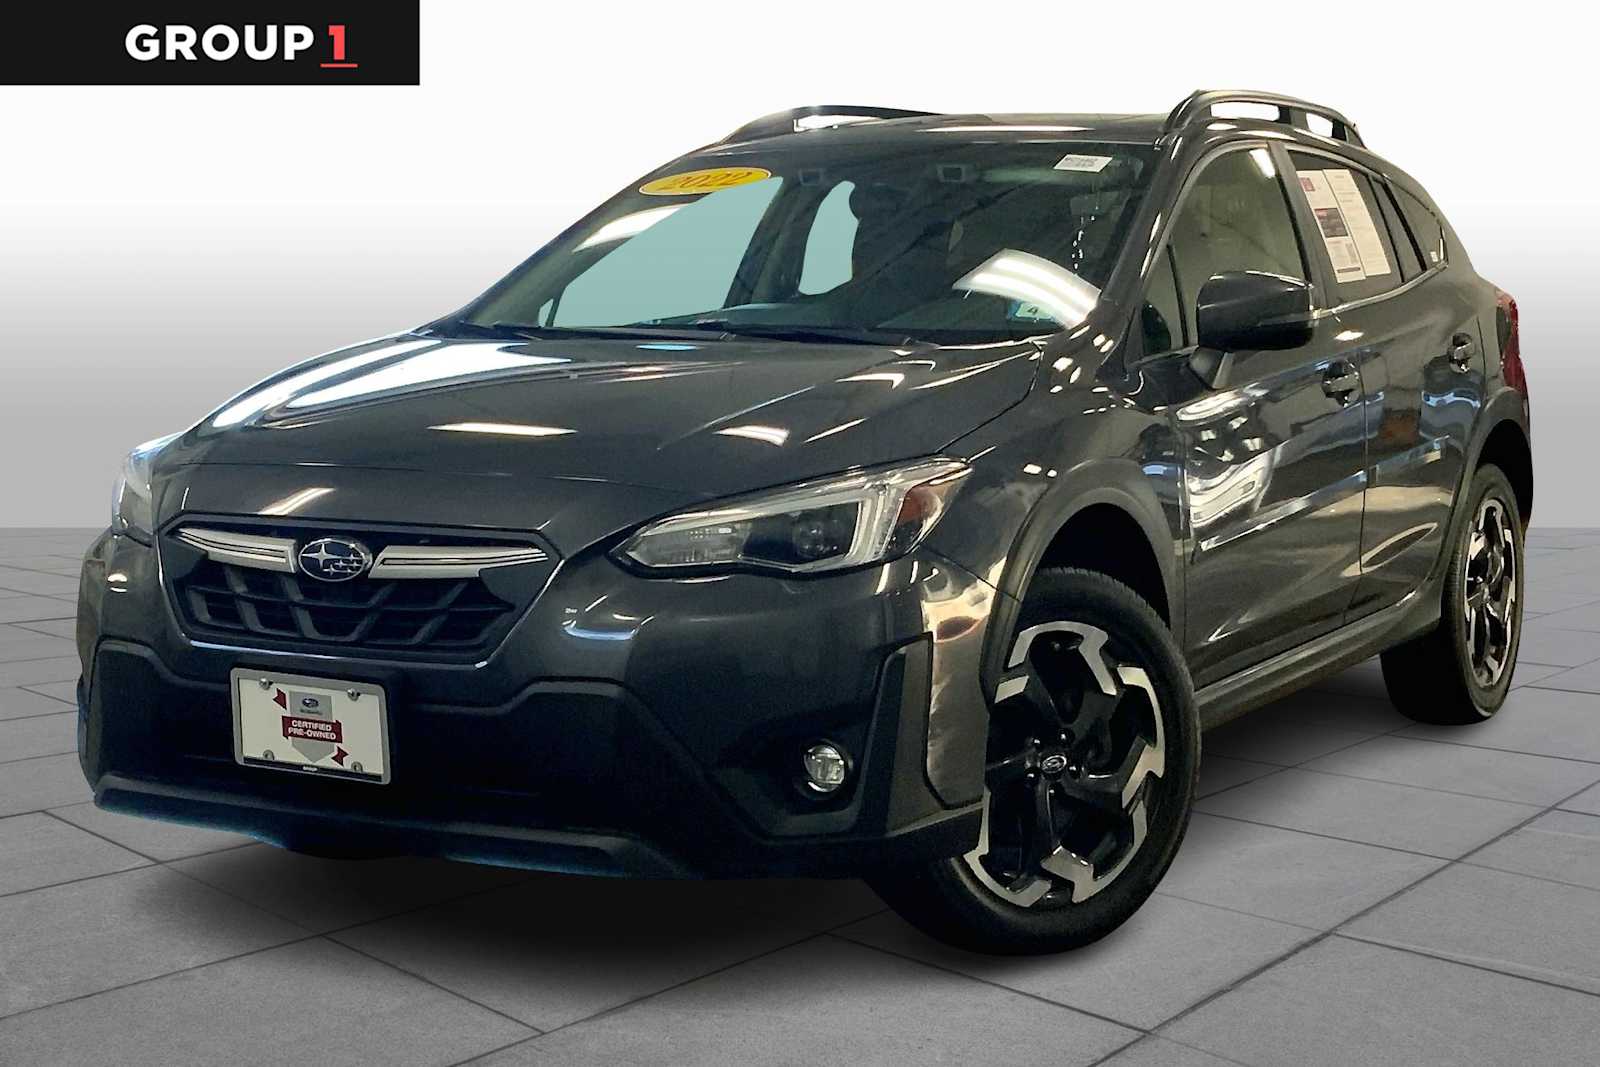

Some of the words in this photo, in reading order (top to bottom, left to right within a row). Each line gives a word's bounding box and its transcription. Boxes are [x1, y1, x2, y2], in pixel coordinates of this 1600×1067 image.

[655, 171, 753, 191] 2022
[291, 719, 332, 732] CERTIFIED
[288, 727, 336, 740] PRE-OWNED
